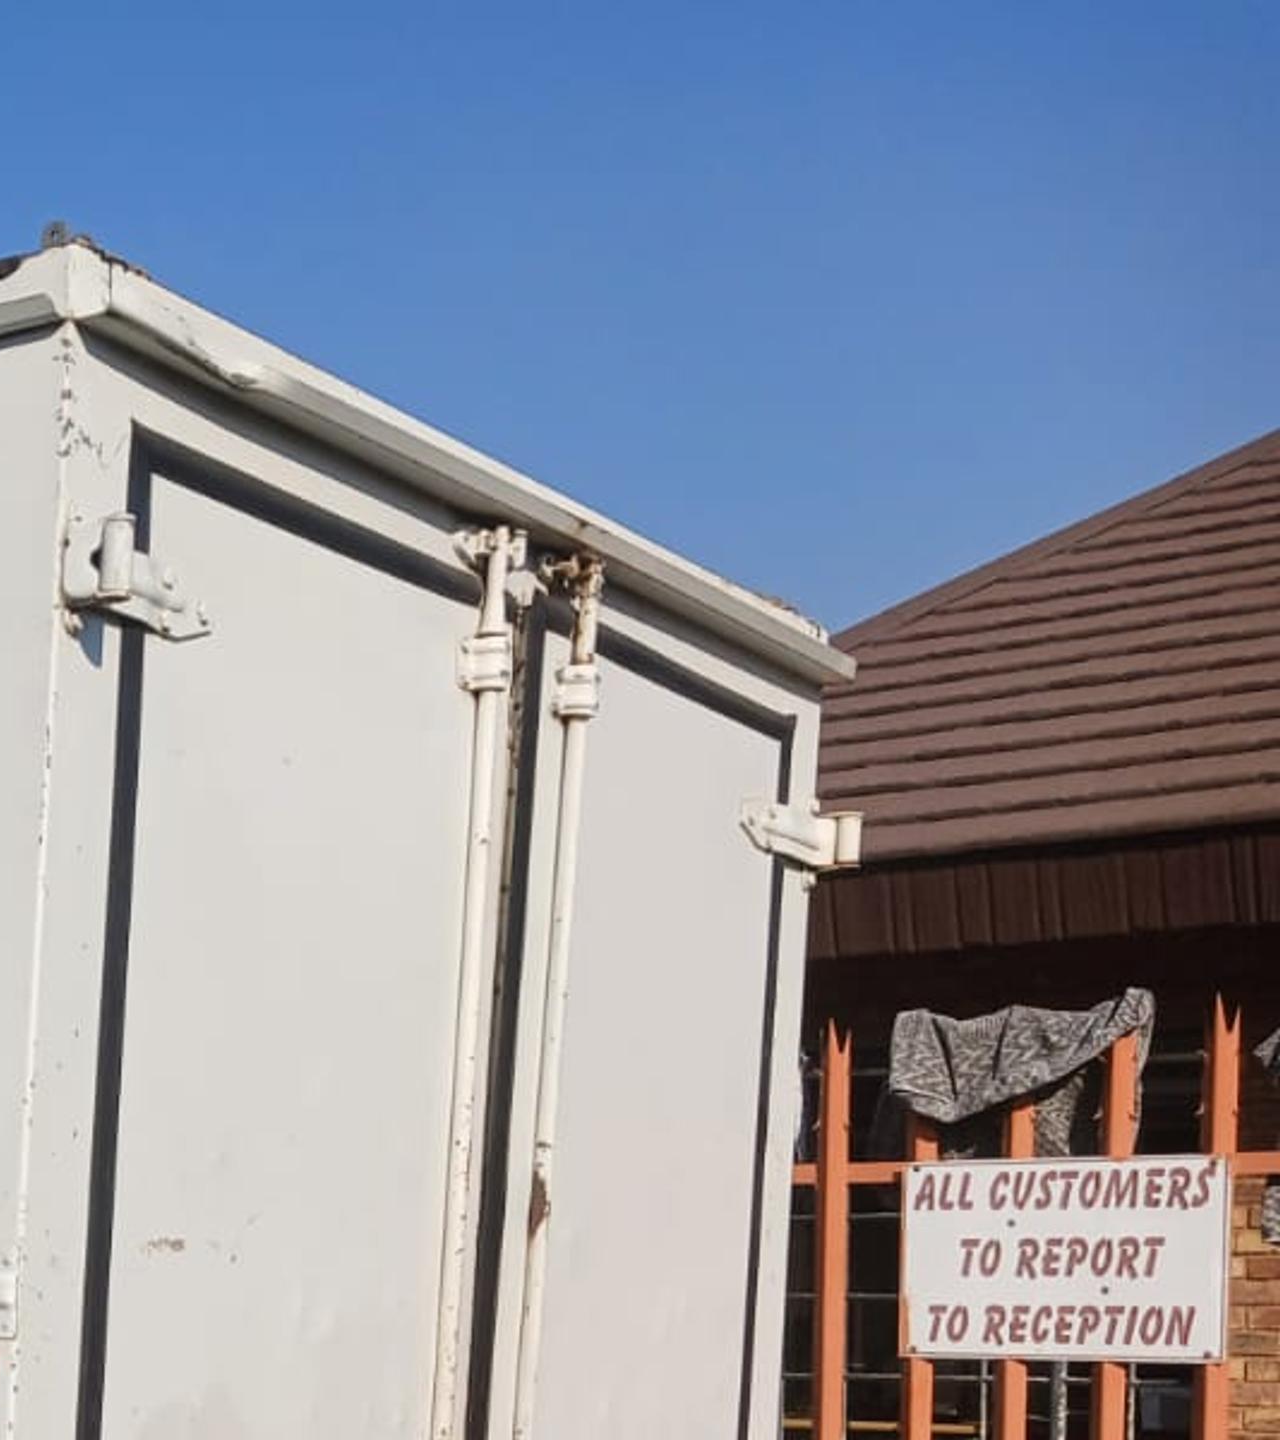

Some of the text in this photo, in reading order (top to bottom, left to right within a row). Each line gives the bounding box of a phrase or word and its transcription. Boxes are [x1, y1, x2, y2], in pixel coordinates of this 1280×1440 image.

[914, 1166, 1217, 1211] ALL CUSTOMERS
[960, 1236, 1166, 1280] TO REPORT
[927, 1304, 1196, 1347] TO RECEPTION
